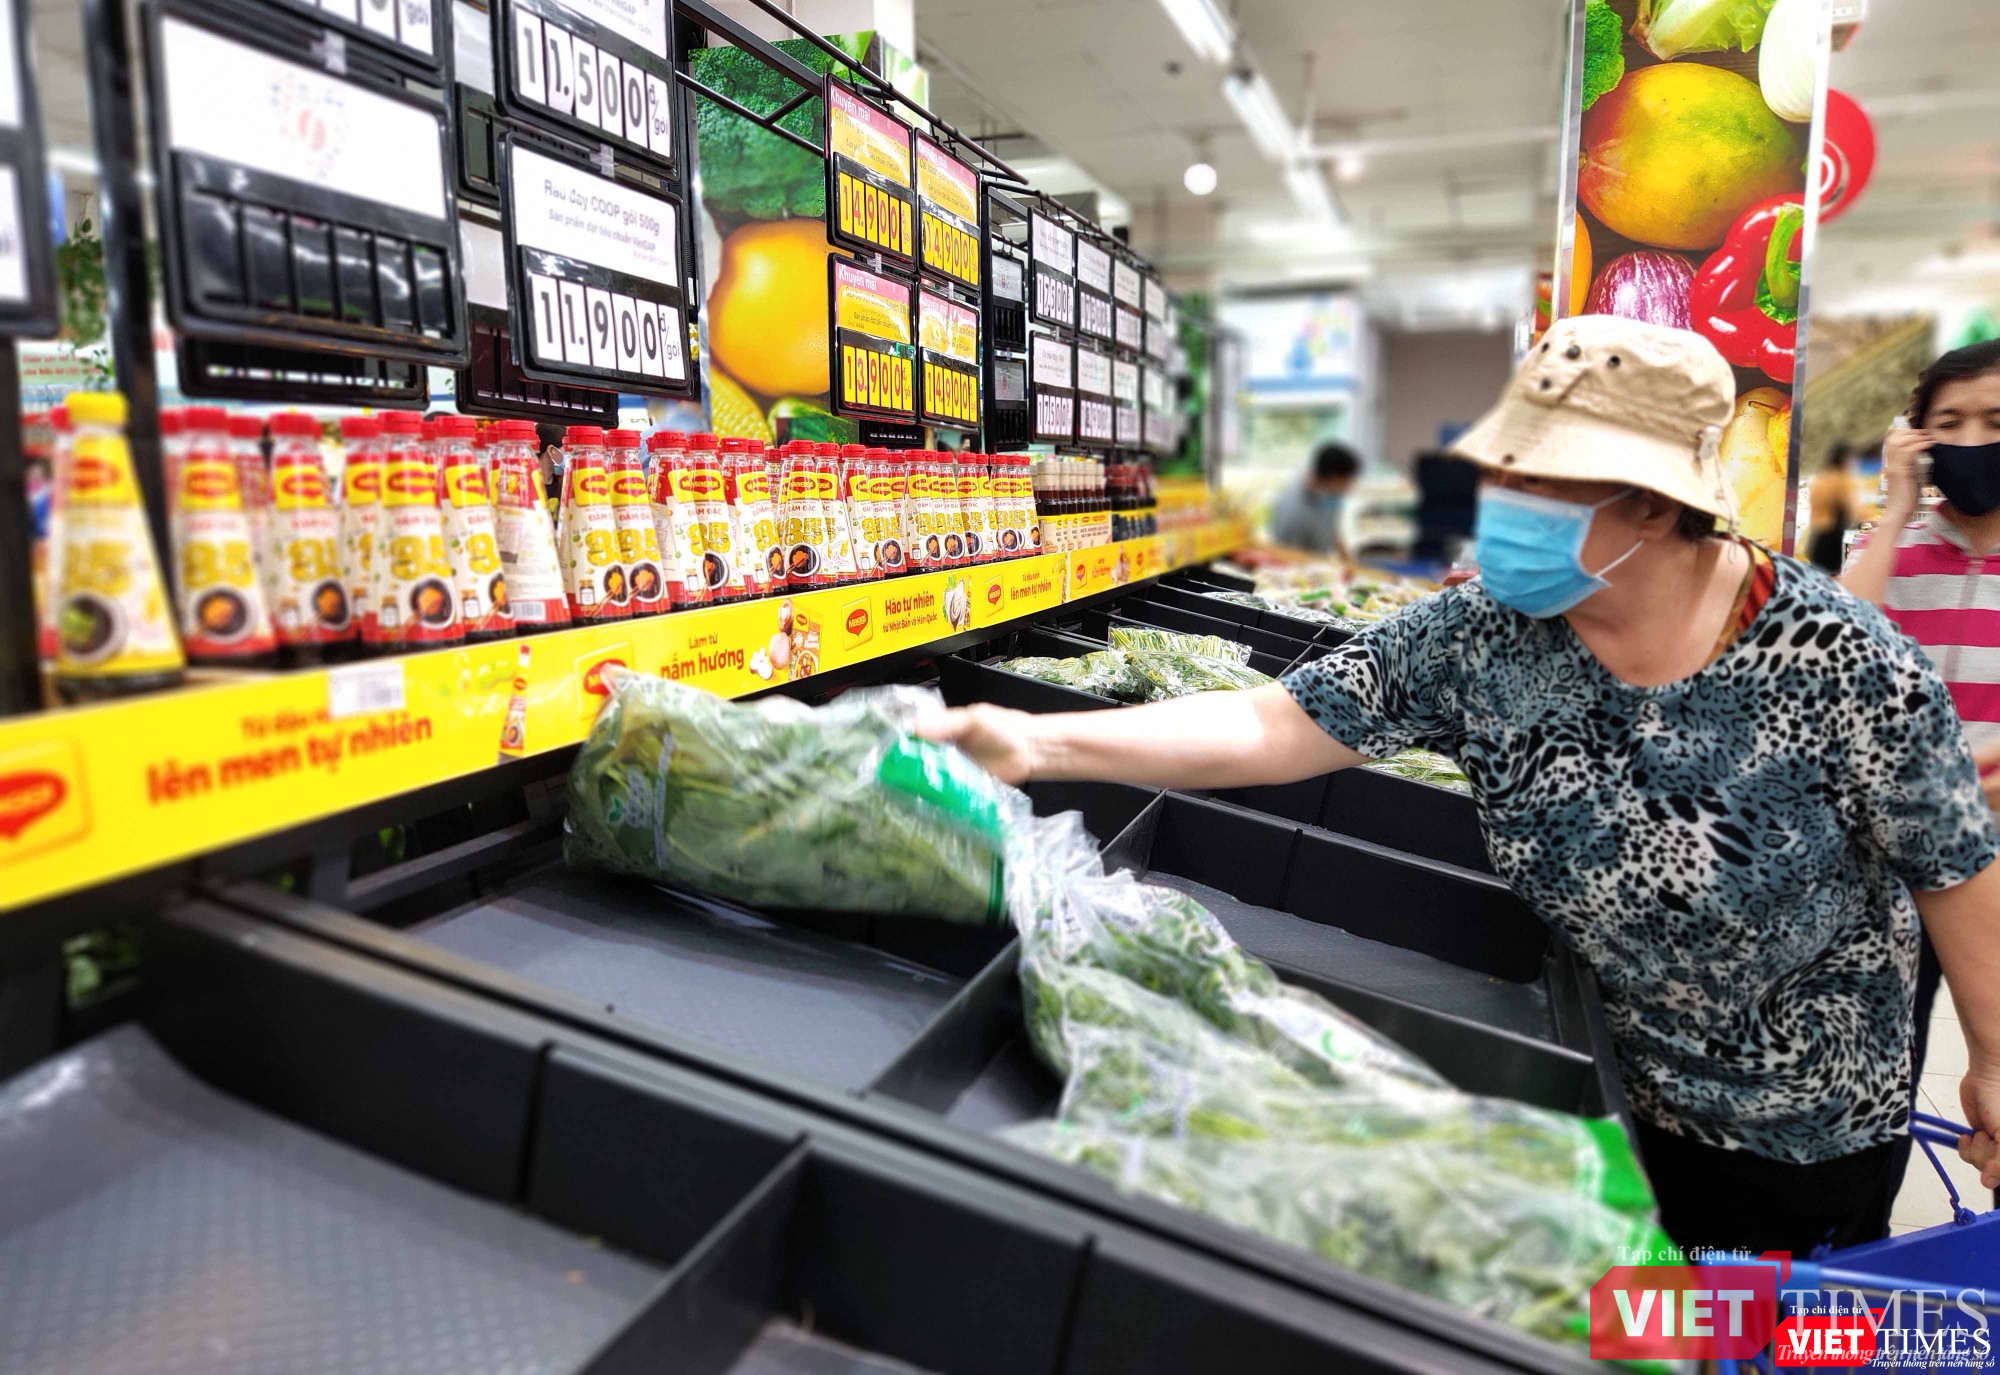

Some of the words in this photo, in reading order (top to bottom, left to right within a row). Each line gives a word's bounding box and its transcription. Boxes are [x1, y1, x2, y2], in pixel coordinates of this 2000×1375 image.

[523, 26, 643, 129] 11.500
[544, 178, 567, 201] Rau
[590, 195, 621, 219] COOP
[622, 209, 638, 227] gói
[639, 213, 661, 238] 500g
[843, 184, 899, 240] 14.900
[540, 291, 658, 361] 11.900
[847, 355, 901, 397] 13.900
[927, 372, 968, 410] 14.900
[885, 597, 902, 616] Hào
[902, 596, 913, 617] tự
[912, 593, 935, 611] nhiên
[1010, 584, 1019, 601] lên
[1019, 584, 1032, 599] men
[1031, 582, 1037, 599] tự
[1037, 578, 1052, 595] nhiên
[688, 637, 708, 650] Làm
[708, 632, 719, 646] từ
[848, 615, 867, 629] Maggi
[889, 619, 902, 634] Nhật
[902, 616, 911, 629] Bản
[917, 615, 926, 626] Hàn
[926, 612, 938, 626] Quốc
[698, 648, 745, 675] hương
[146, 757, 212, 808] lên
[217, 745, 304, 790] men
[304, 730, 344, 775] tự
[348, 710, 434, 758] nhiên
